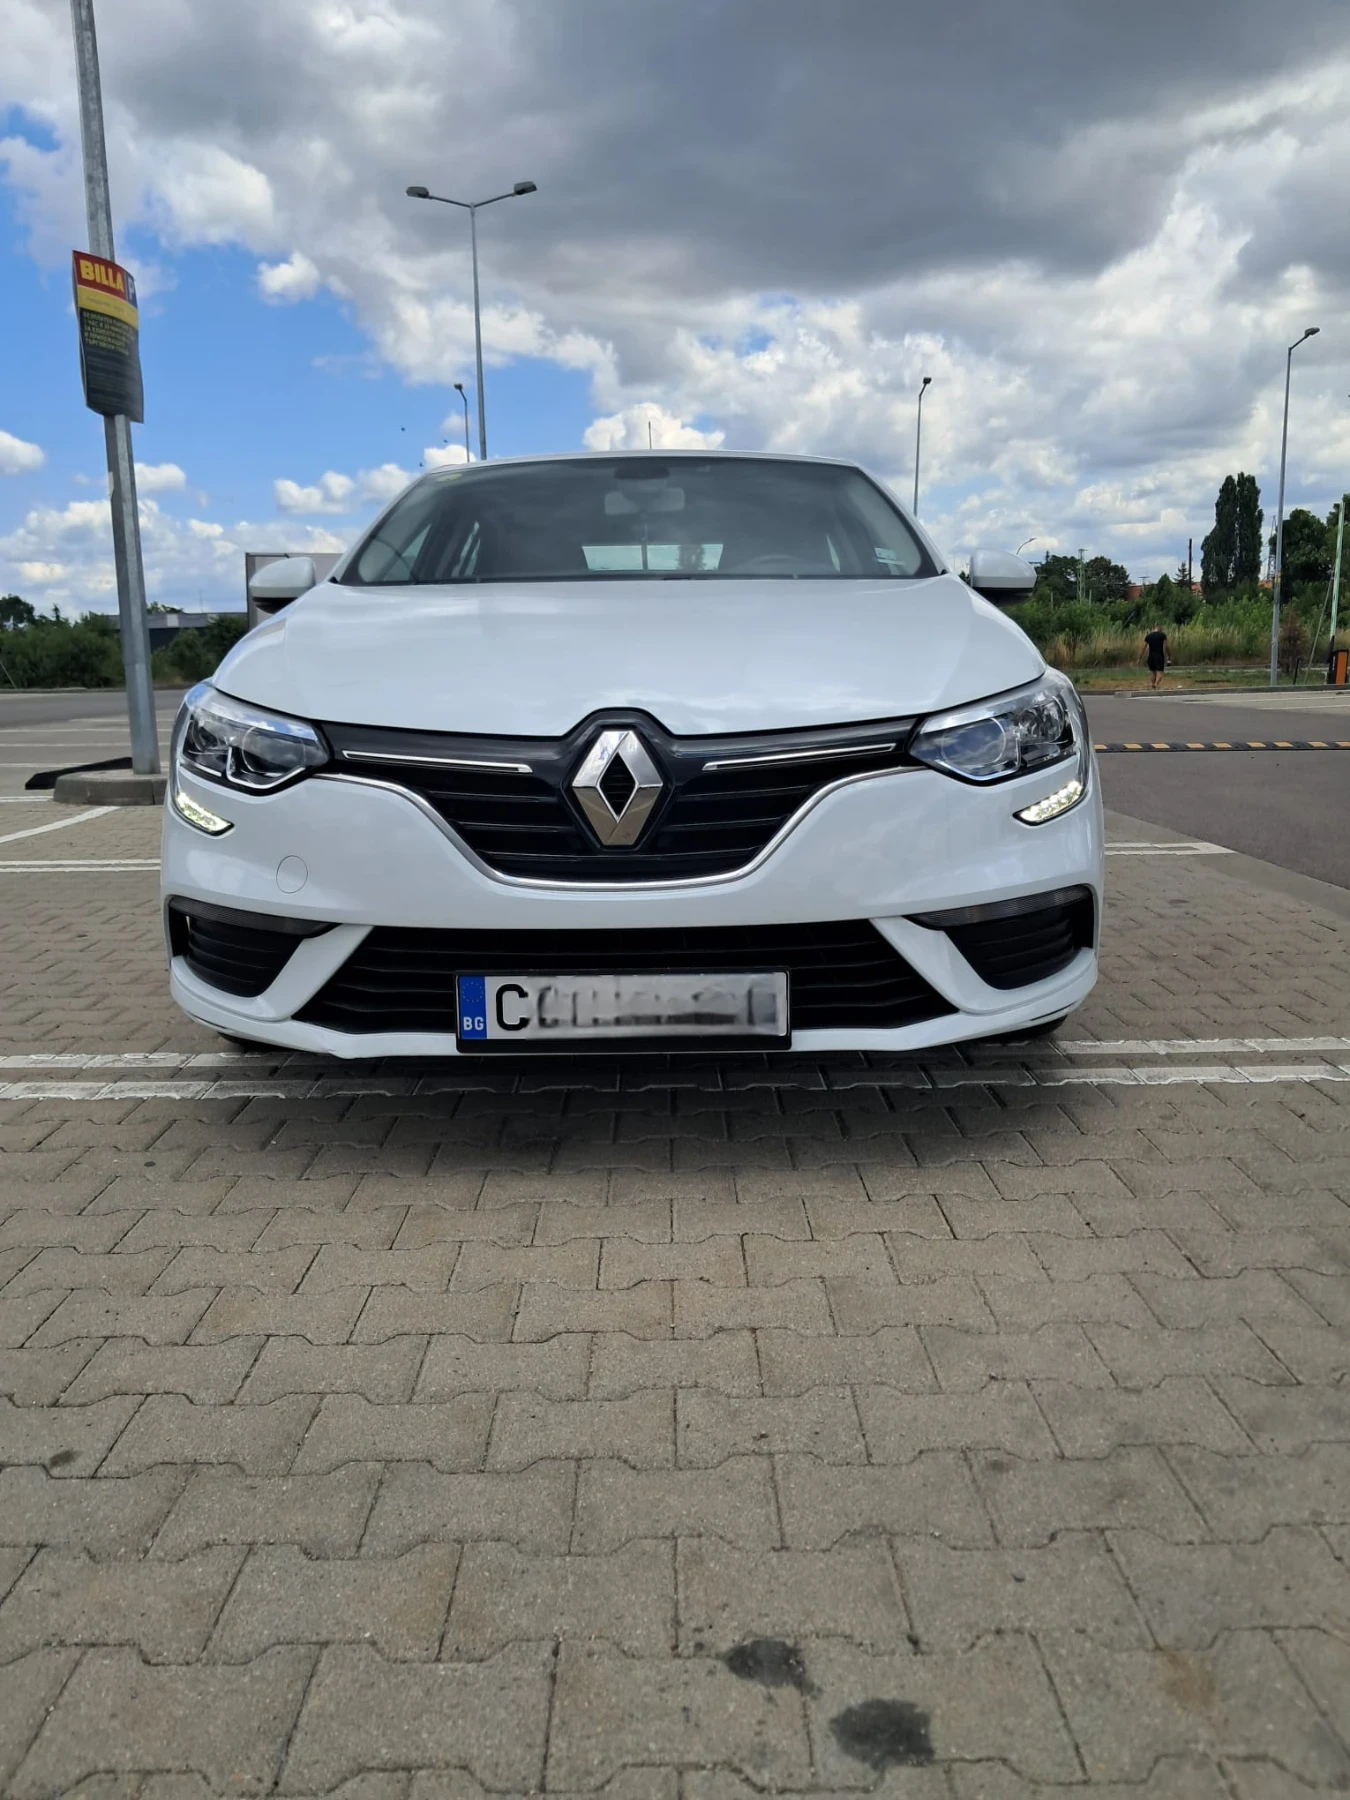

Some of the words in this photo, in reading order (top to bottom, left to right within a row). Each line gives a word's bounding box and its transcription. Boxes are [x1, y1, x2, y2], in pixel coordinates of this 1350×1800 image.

[80, 260, 124, 293] BILLA
[128, 276, 135, 300] P
[463, 1016, 484, 1031] BG
